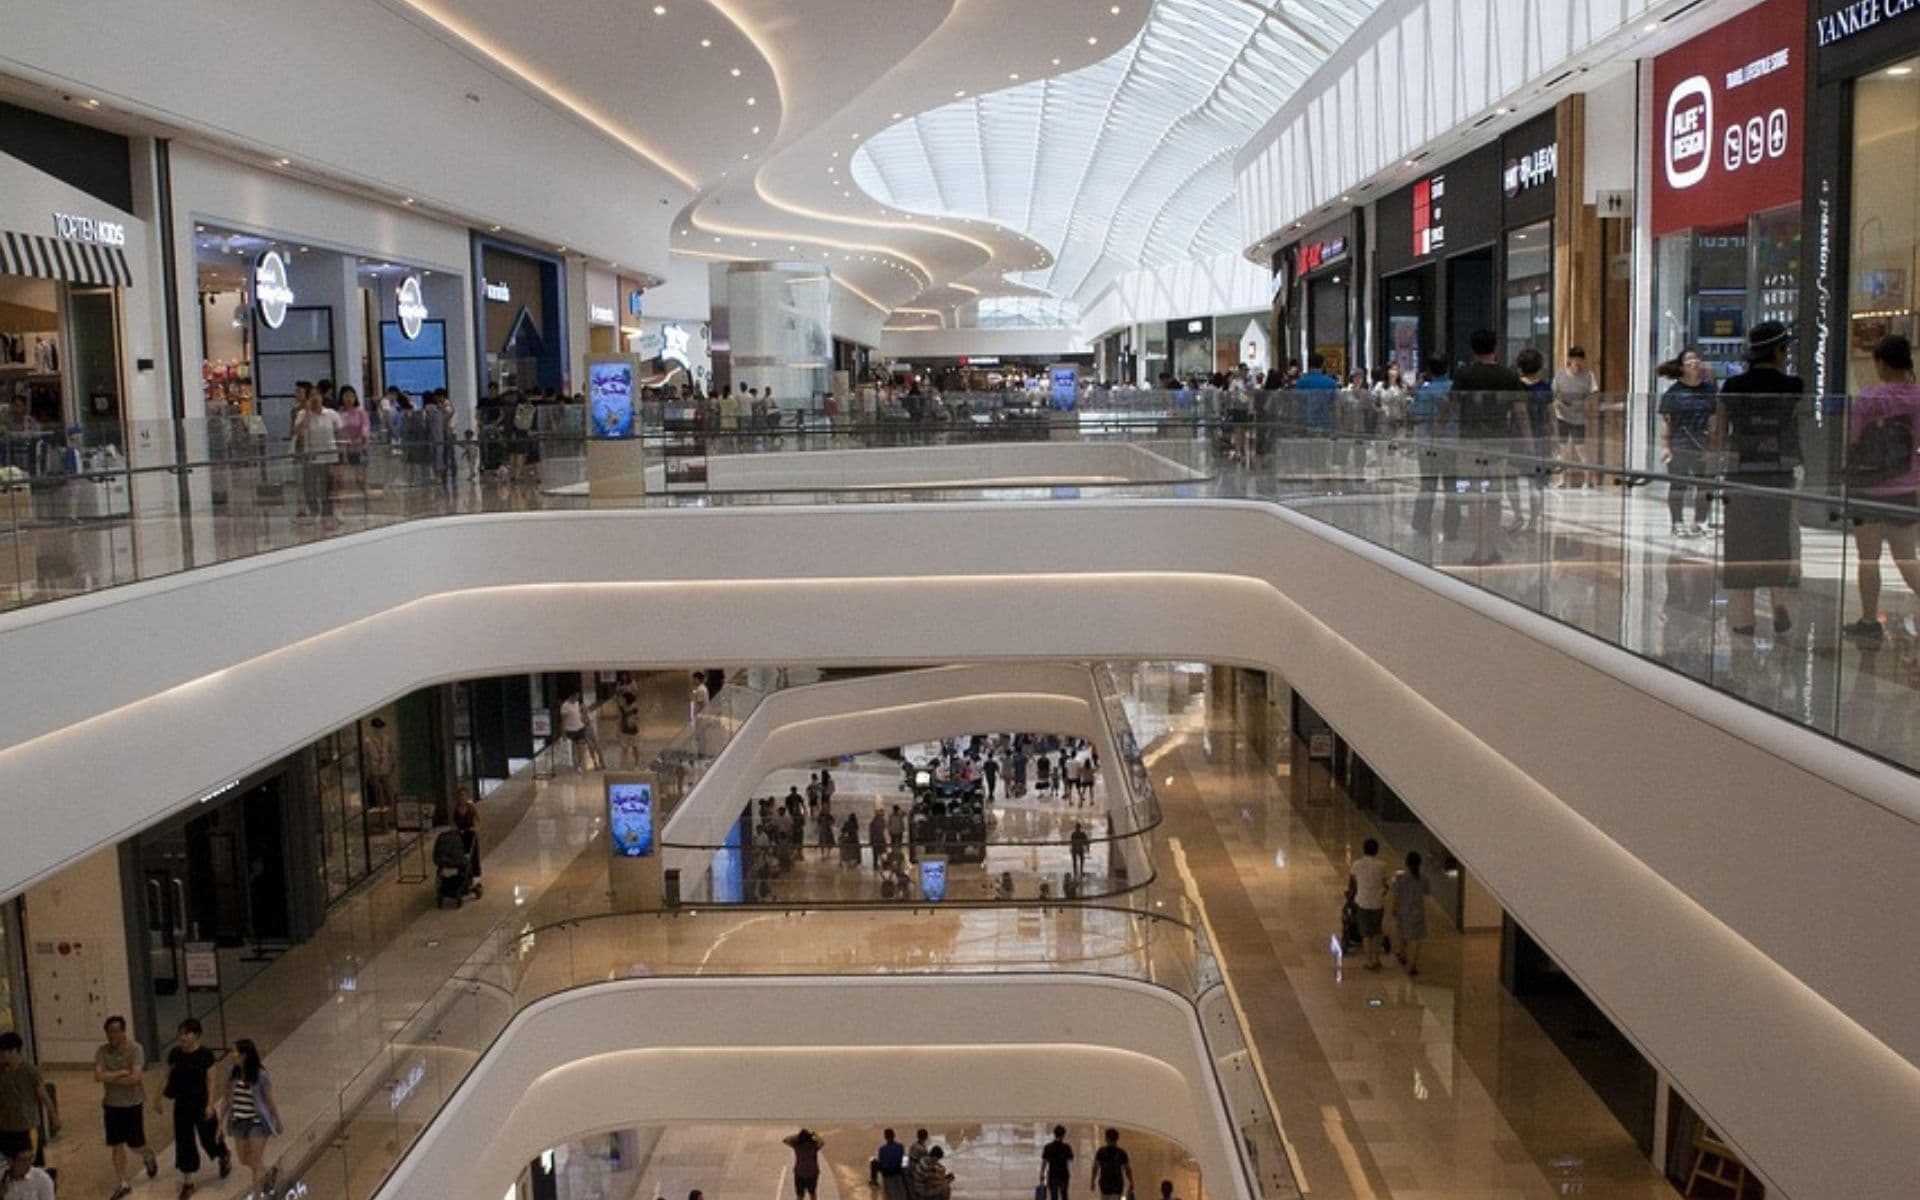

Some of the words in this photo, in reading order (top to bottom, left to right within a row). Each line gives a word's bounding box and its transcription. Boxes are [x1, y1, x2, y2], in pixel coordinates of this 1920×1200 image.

[1816, 0, 1881, 47] YANKEE
[52, 212, 98, 242] TOPTEN
[98, 220, 125, 246] KIDS
